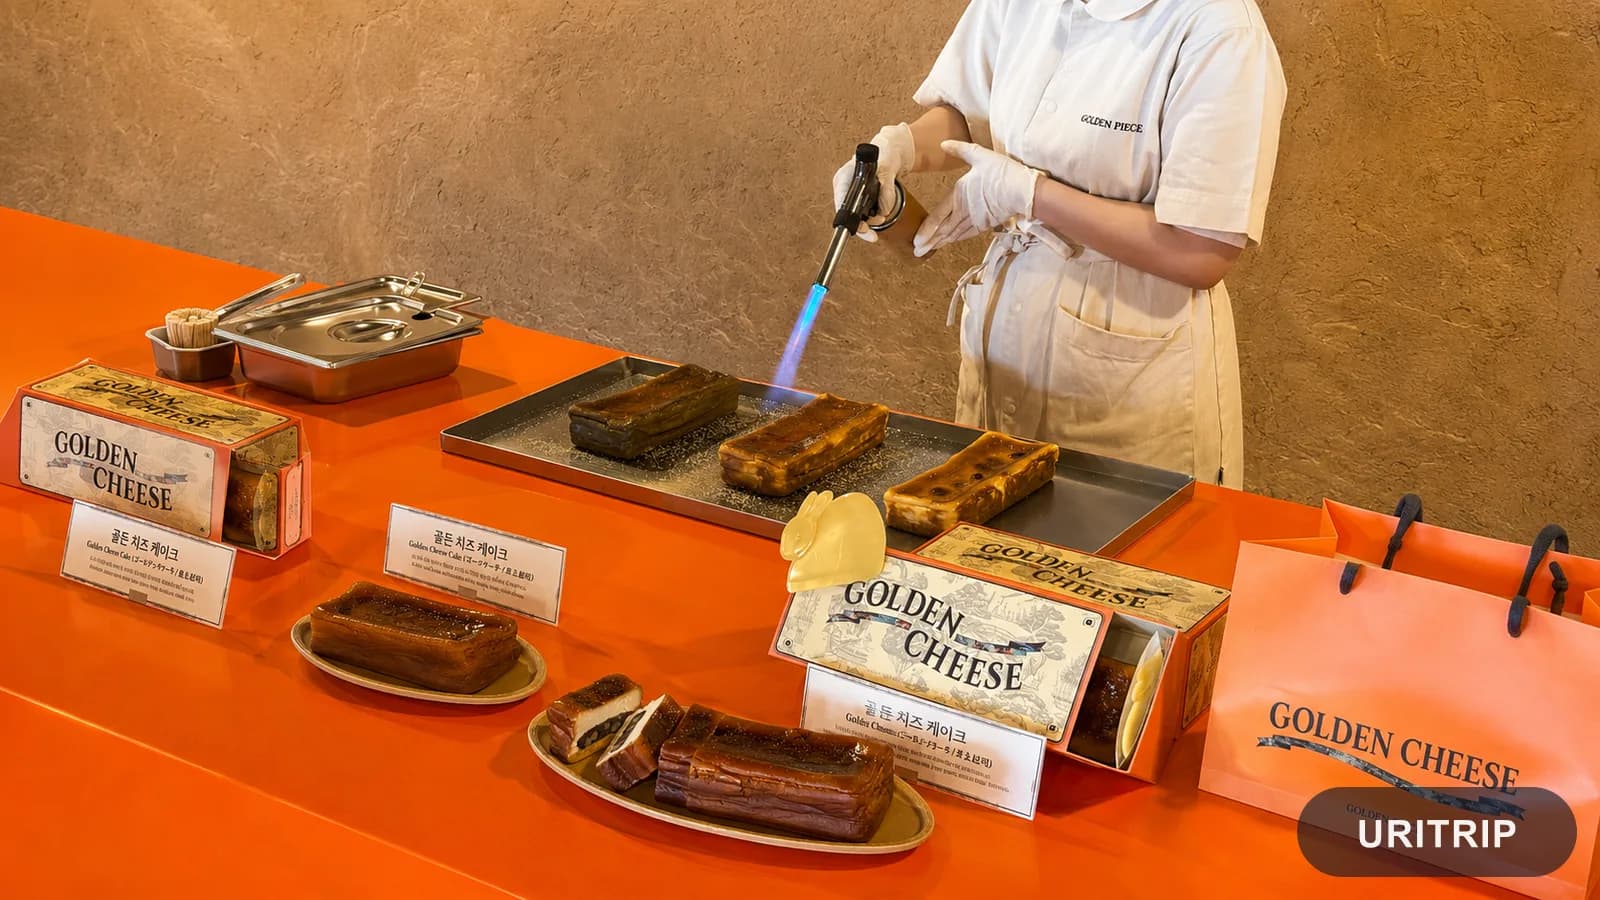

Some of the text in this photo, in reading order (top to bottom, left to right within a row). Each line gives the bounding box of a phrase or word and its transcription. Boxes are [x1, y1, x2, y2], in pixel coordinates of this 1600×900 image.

[1081, 114, 1143, 133] GOLDEN PIECE
[94, 379, 183, 406] GOLDEN
[126, 399, 215, 428] CHEESE
[55, 430, 138, 474] GOLDEN
[93, 466, 173, 511] CHEESE
[112, 528, 179, 561] 골든 치즈 케이크
[434, 529, 508, 561] 골든 치즈 케이크
[979, 543, 1093, 579] GOLDEN
[1032, 569, 1149, 609] CHEESE
[844, 580, 965, 639] GOLDEN
[904, 629, 1023, 691] CHEESE
[896, 711, 923, 731] 치즈
[926, 719, 967, 744] 케이크
[1269, 701, 1520, 796] GOLDEN CHEESE
